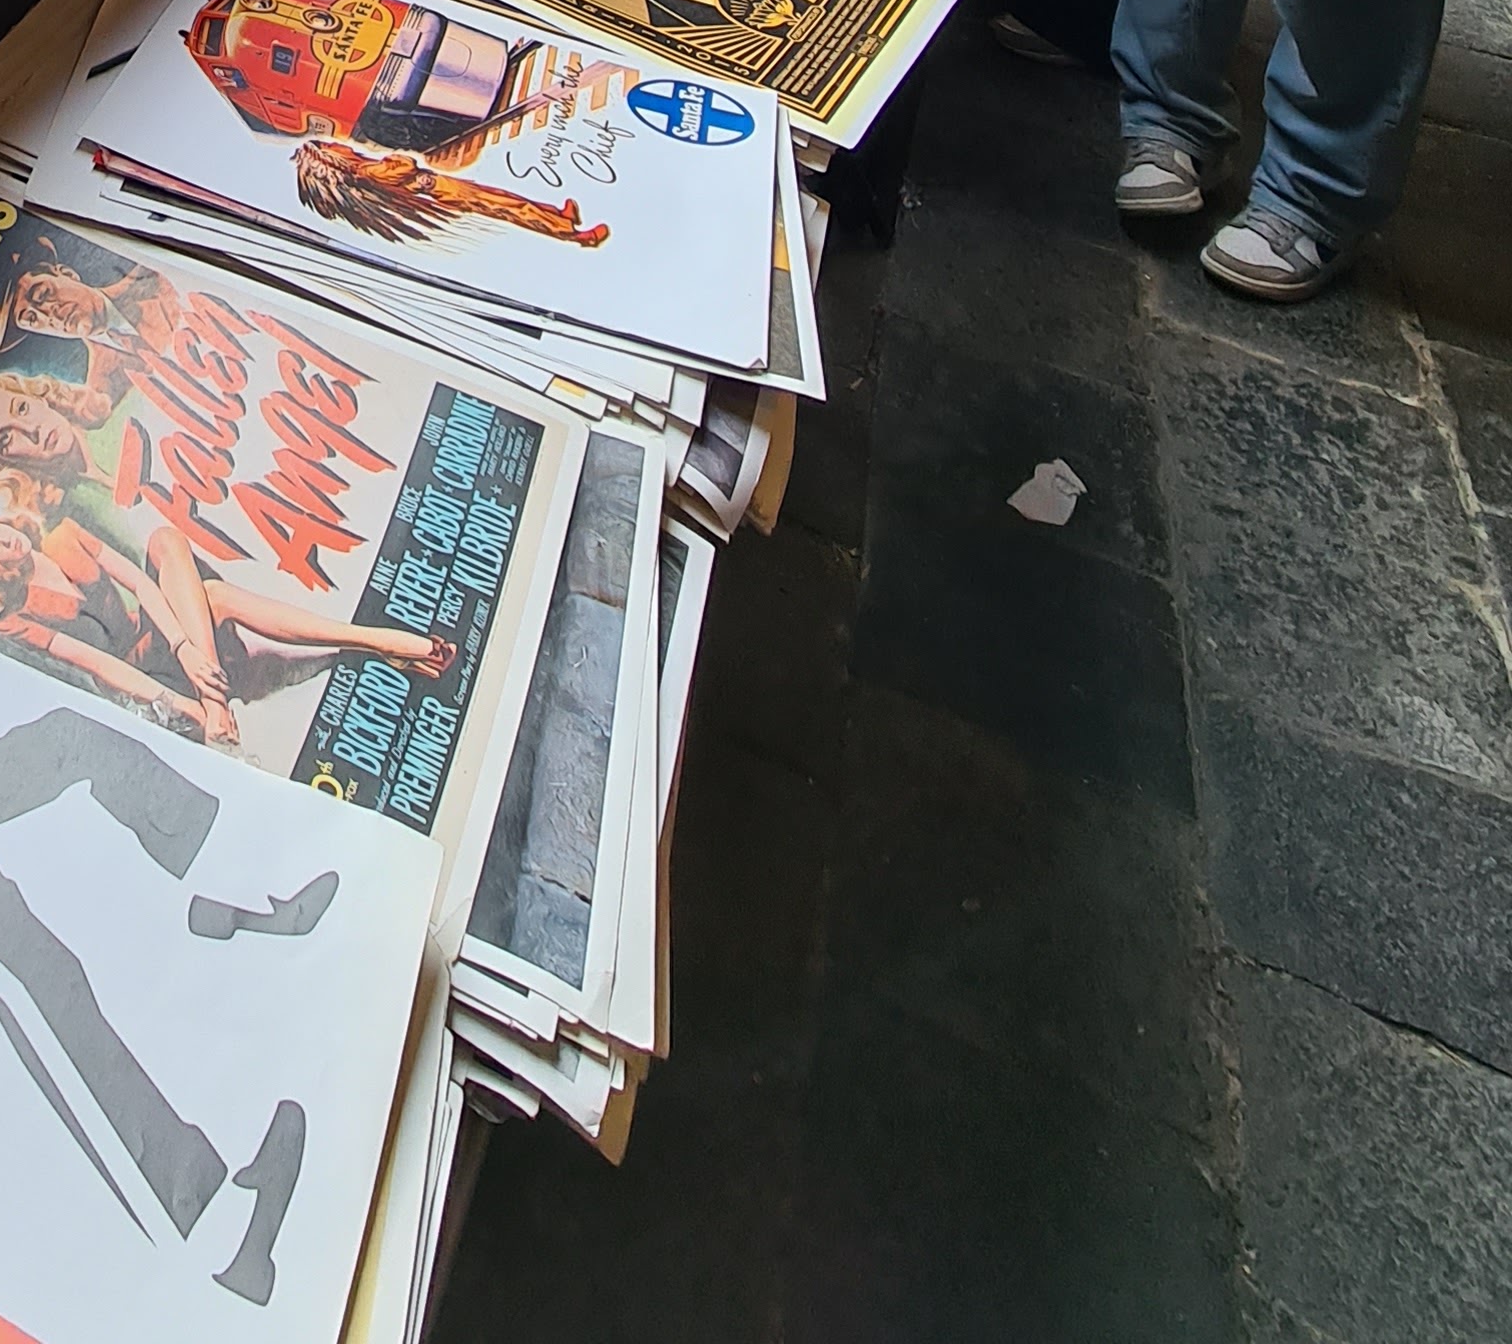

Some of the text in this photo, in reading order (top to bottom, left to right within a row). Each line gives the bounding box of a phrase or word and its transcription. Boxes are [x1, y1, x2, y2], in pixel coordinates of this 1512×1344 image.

[275, 51, 292, 66] 19
[333, 1, 373, 62] SANTA FE
[677, 43, 751, 77] 2015
[506, 61, 584, 187] Every inch the
[672, 85, 707, 141] Santa Fe
[570, 118, 636, 184] Chief
[422, 414, 446, 446] JOHN
[432, 391, 496, 490] CARRADINE
[395, 484, 422, 524] BRUCE
[411, 484, 468, 555] CABOT
[369, 556, 398, 595] ANNE
[385, 550, 448, 633] REVERE
[436, 582, 466, 628] PERCY
[451, 490, 518, 597] KILBRIDE
[319, 664, 359, 727] CHARLES
[332, 659, 411, 777] BICKFORD
[387, 756, 397, 780] and
[393, 717, 412, 762] Directed
[406, 707, 418, 723] by
[389, 695, 460, 825] PREMINGER
